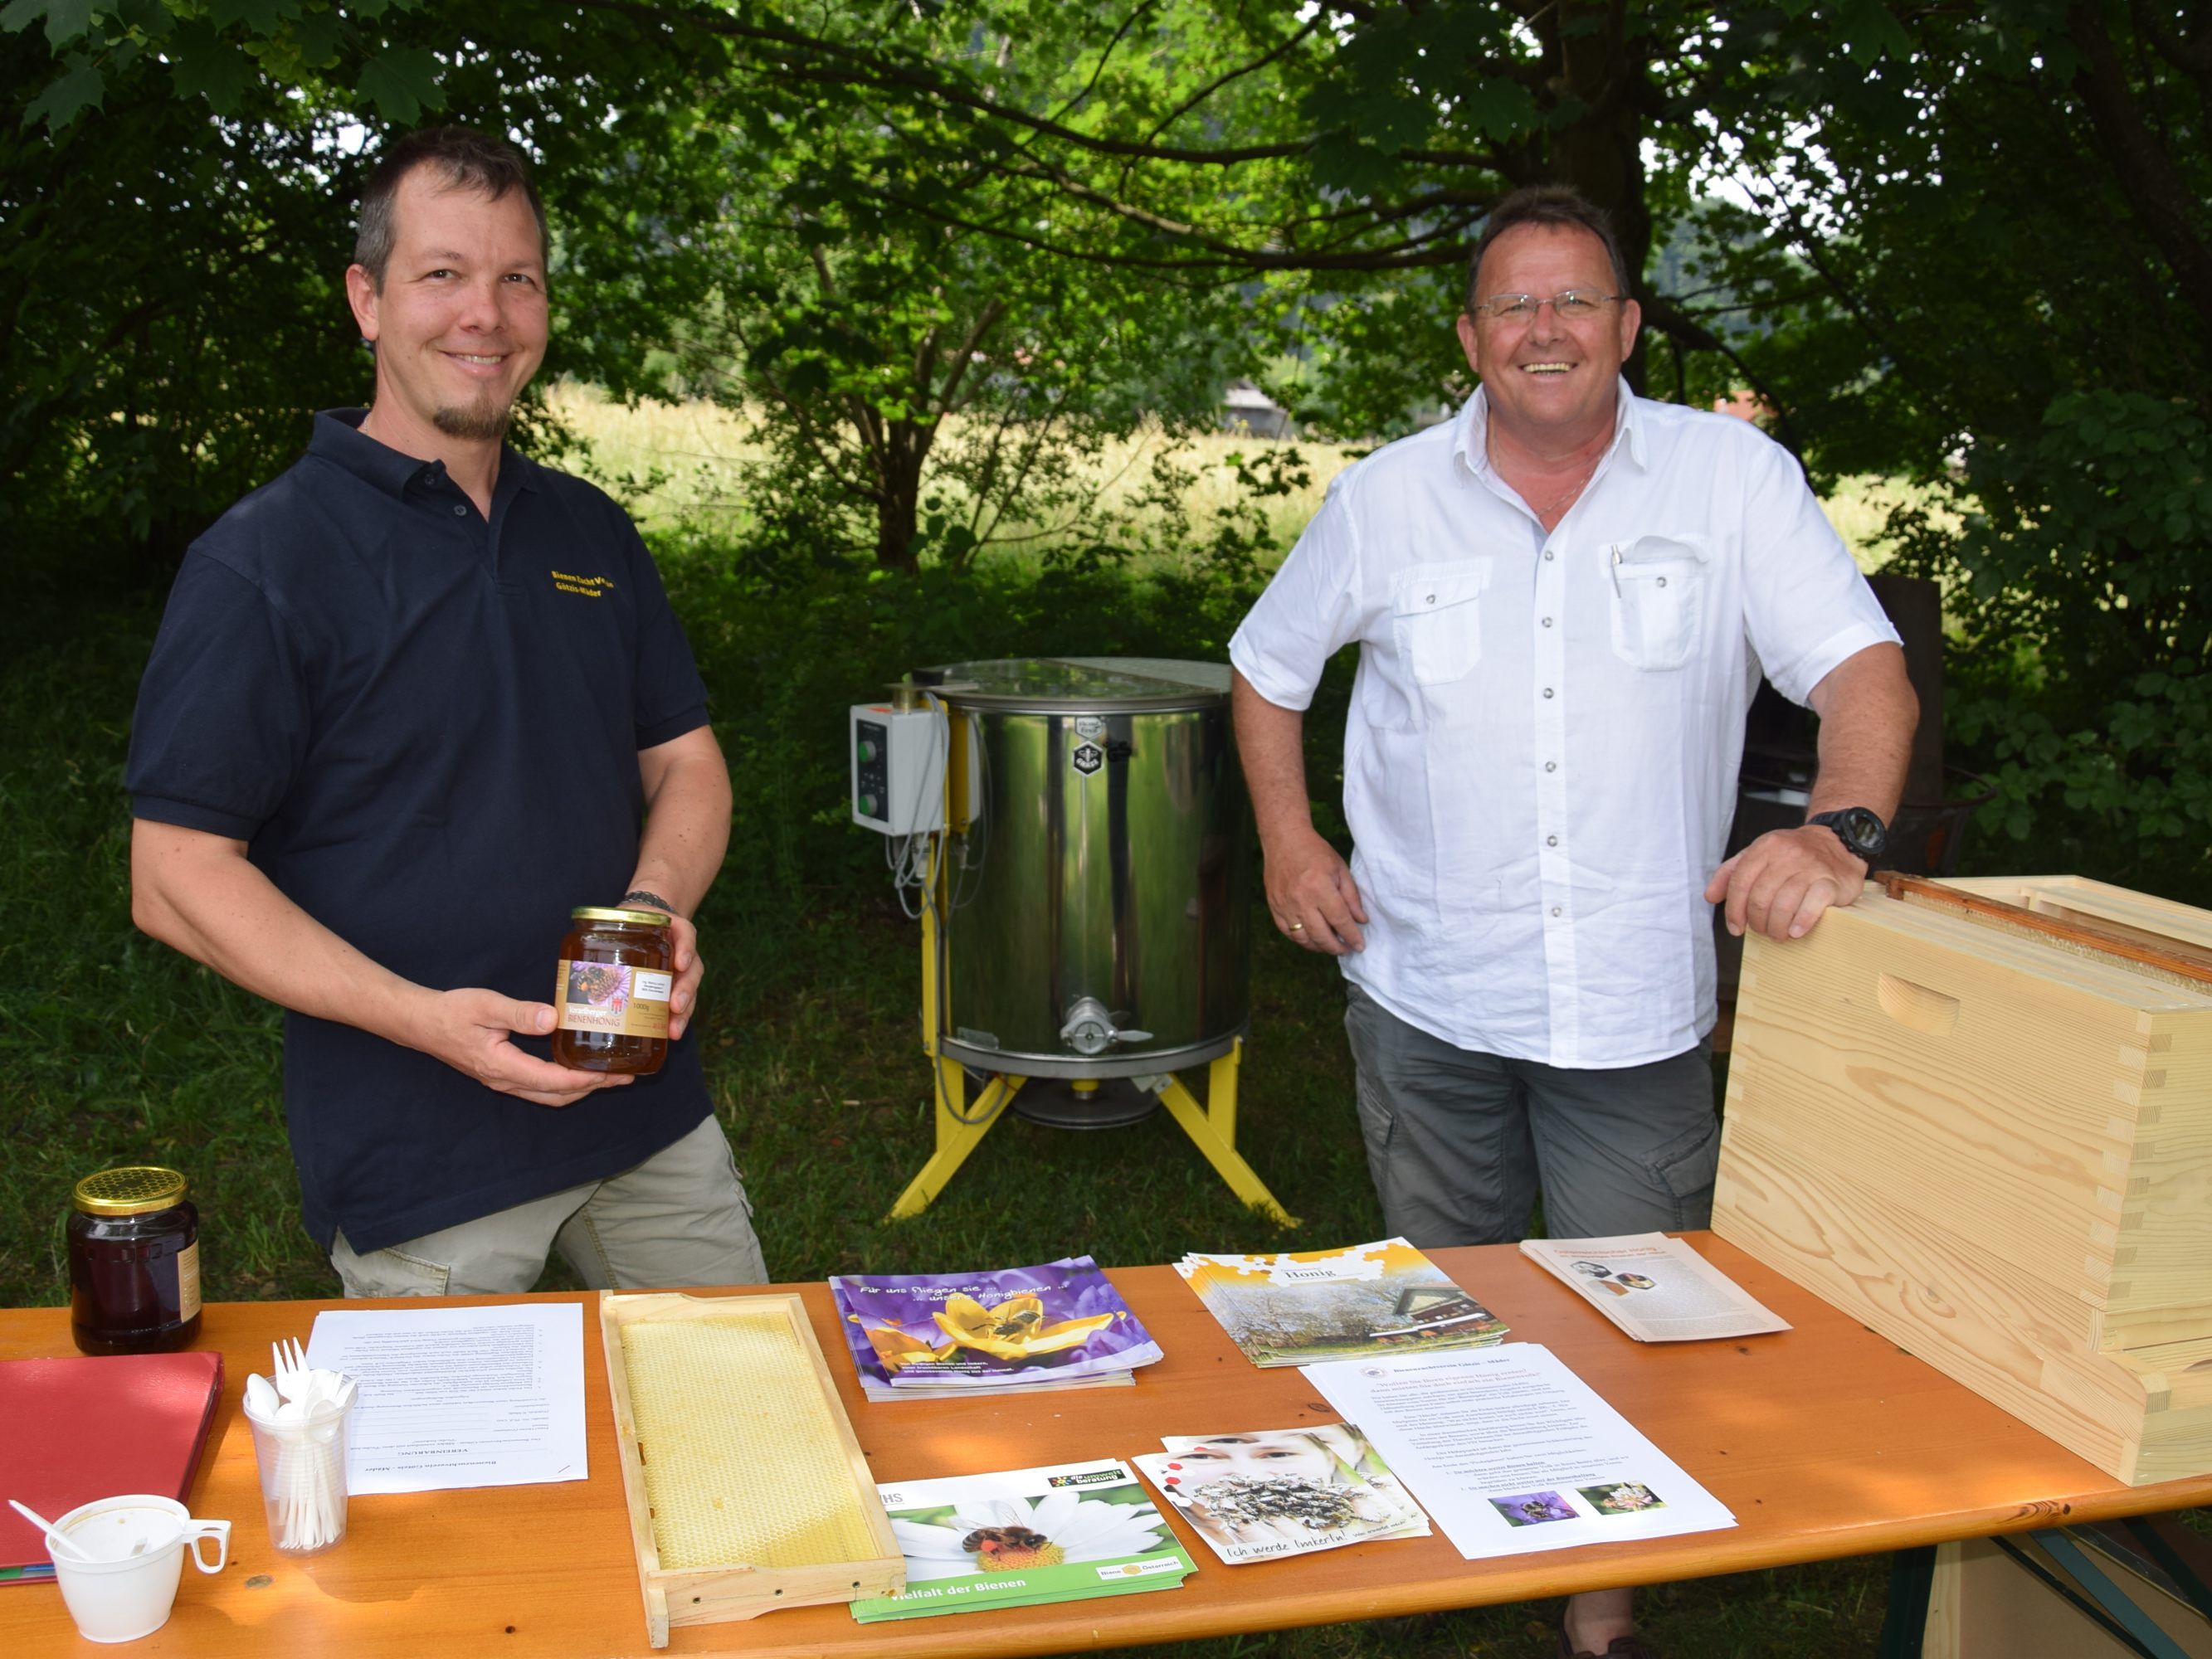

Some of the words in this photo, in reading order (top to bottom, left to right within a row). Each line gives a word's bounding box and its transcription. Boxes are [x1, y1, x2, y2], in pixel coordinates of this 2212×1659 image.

[1285, 1269, 1336, 1278] Honig
[911, 1287, 957, 1297] fliegen
[978, 1285, 1051, 1300] Honigbienen
[1075, 1475, 1118, 1483] beratung
[1084, 1470, 1122, 1479] umwelt
[1226, 1547, 1248, 1558] Ich
[1253, 1543, 1289, 1554] werde
[947, 1585, 971, 1595] der
[975, 1579, 1026, 1592] Bienen
